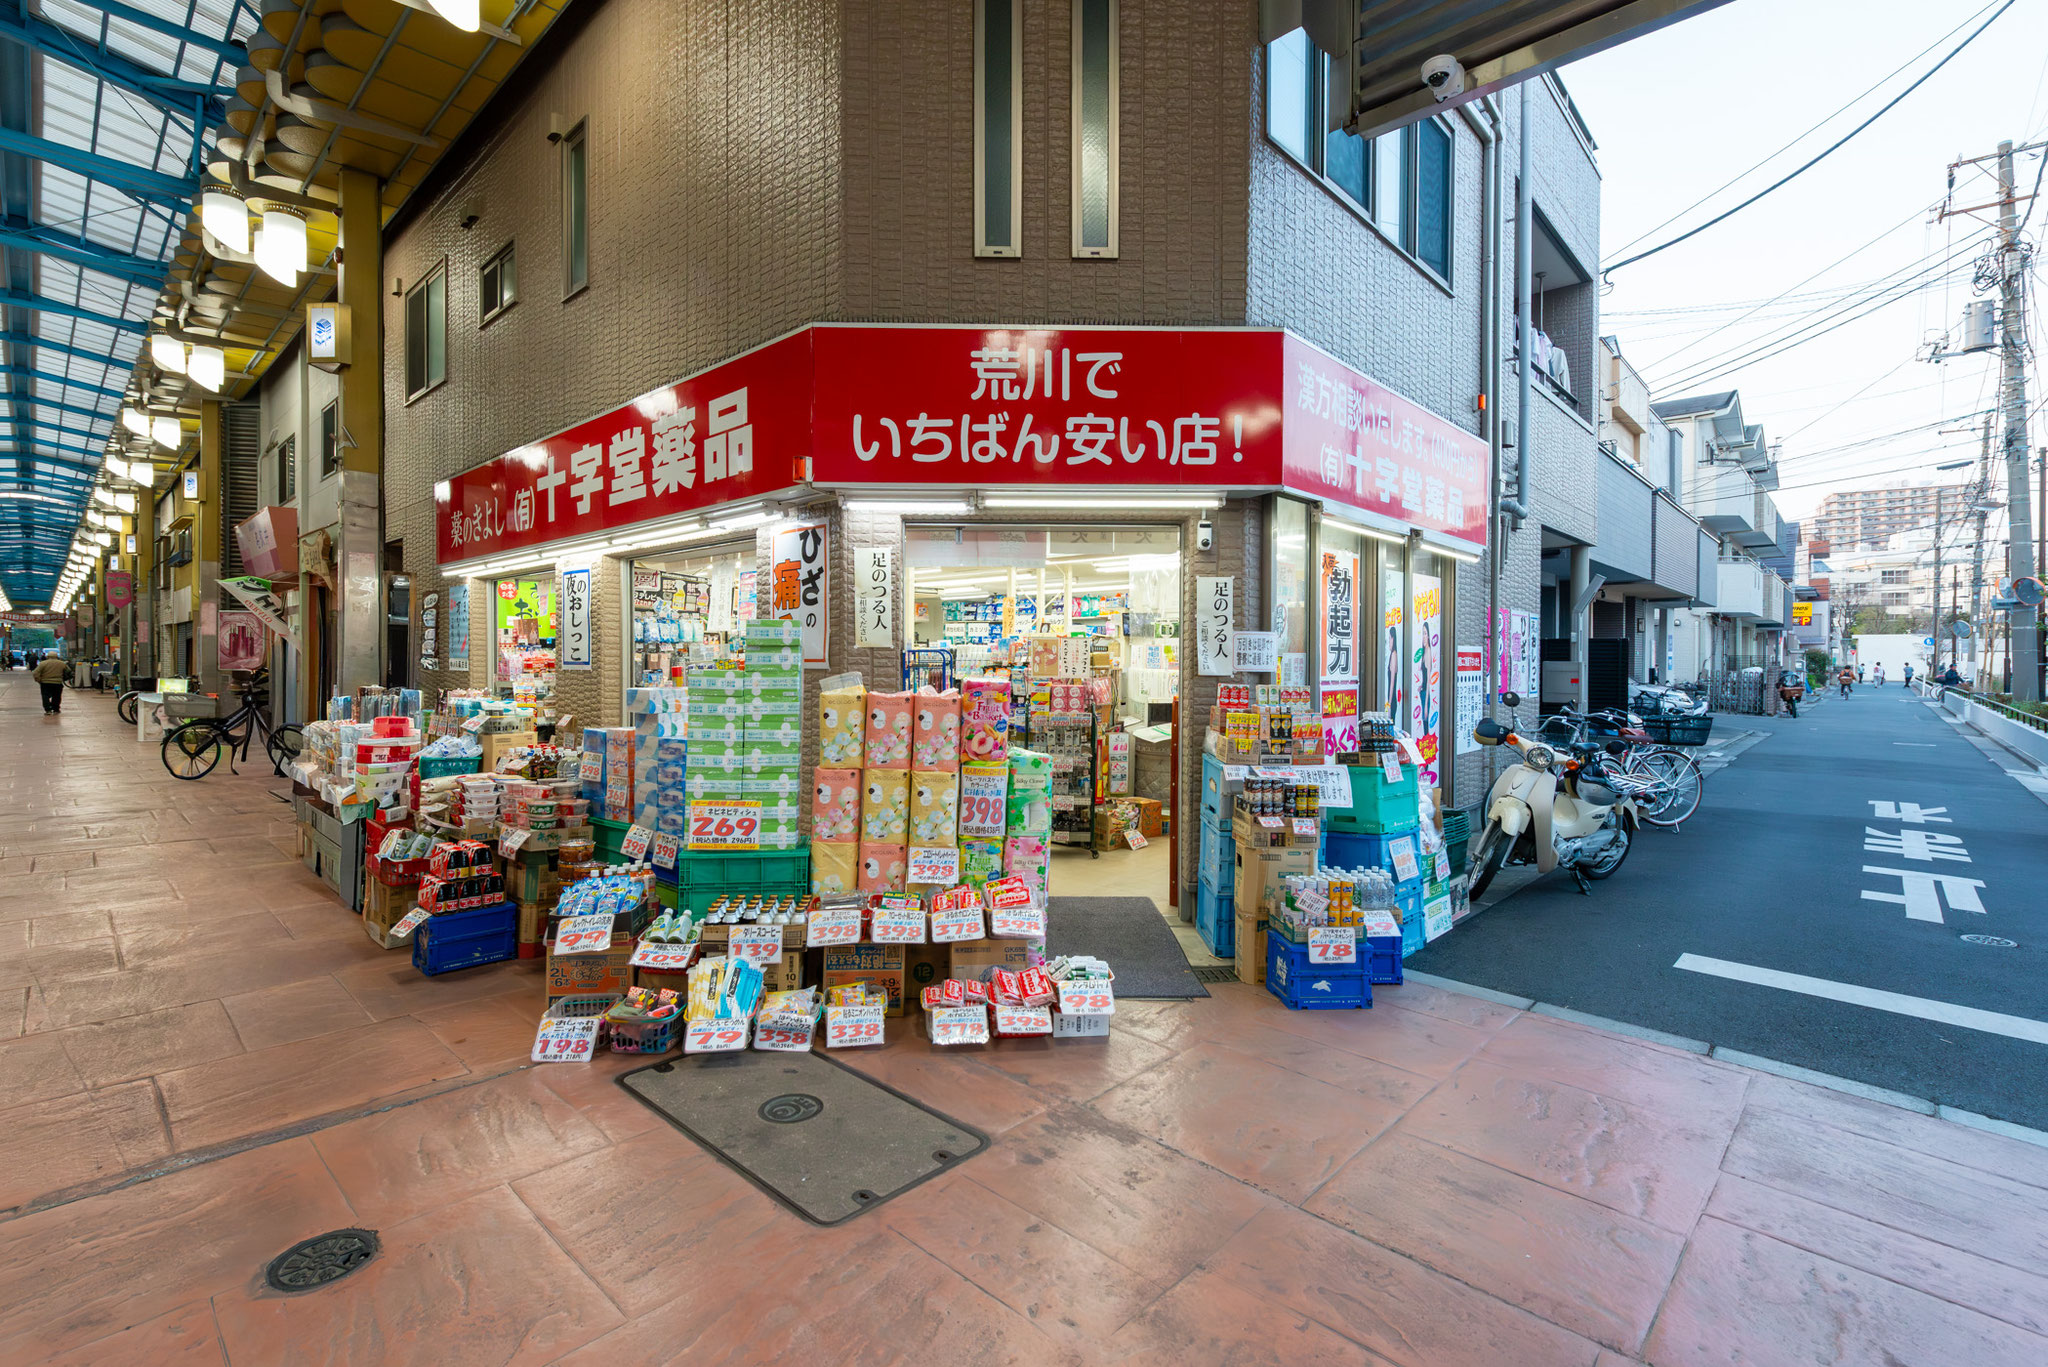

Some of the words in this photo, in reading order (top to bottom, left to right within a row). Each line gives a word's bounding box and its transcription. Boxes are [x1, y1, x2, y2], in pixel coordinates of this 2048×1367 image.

[970, 347, 1123, 401] 荒川で
[852, 410, 1243, 465] いちばん安い店!
[450, 497, 505, 548] 薬のきよし
[799, 527, 825, 627] ひざの
[774, 558, 801, 620] 痛
[871, 552, 888, 630] 足のつる人
[566, 573, 587, 662] 夜のおしっこ
[1213, 581, 1229, 658] 足のつる人
[1327, 567, 1352, 674] 勃起力
[977, 701, 1000, 712] Fruit
[972, 711, 1003, 721] Basket
[581, 765, 600, 776] 598
[961, 796, 1004, 825] 398
[692, 816, 758, 837] 269
[623, 838, 646, 854] 398
[655, 843, 676, 859] 398
[968, 853, 992, 864] Fruit
[912, 864, 955, 876] 398
[965, 863, 994, 872] Basket
[813, 924, 858, 940] 398
[877, 925, 923, 937] 398
[935, 922, 980, 936] 378
[996, 919, 1041, 931] 398
[560, 930, 607, 947] 99
[732, 943, 779, 957] 139
[1311, 943, 1353, 957] 78
[638, 952, 687, 963] 109
[550, 968, 567, 978] 2L
[630, 986, 648, 996] SOFT
[1064, 994, 1111, 1008] 98
[1001, 1016, 1048, 1027] 398
[759, 1028, 808, 1044] 358
[831, 1023, 880, 1039] 338
[937, 1023, 984, 1036] 378
[690, 1031, 742, 1045] 79
[538, 1039, 590, 1054] 198
